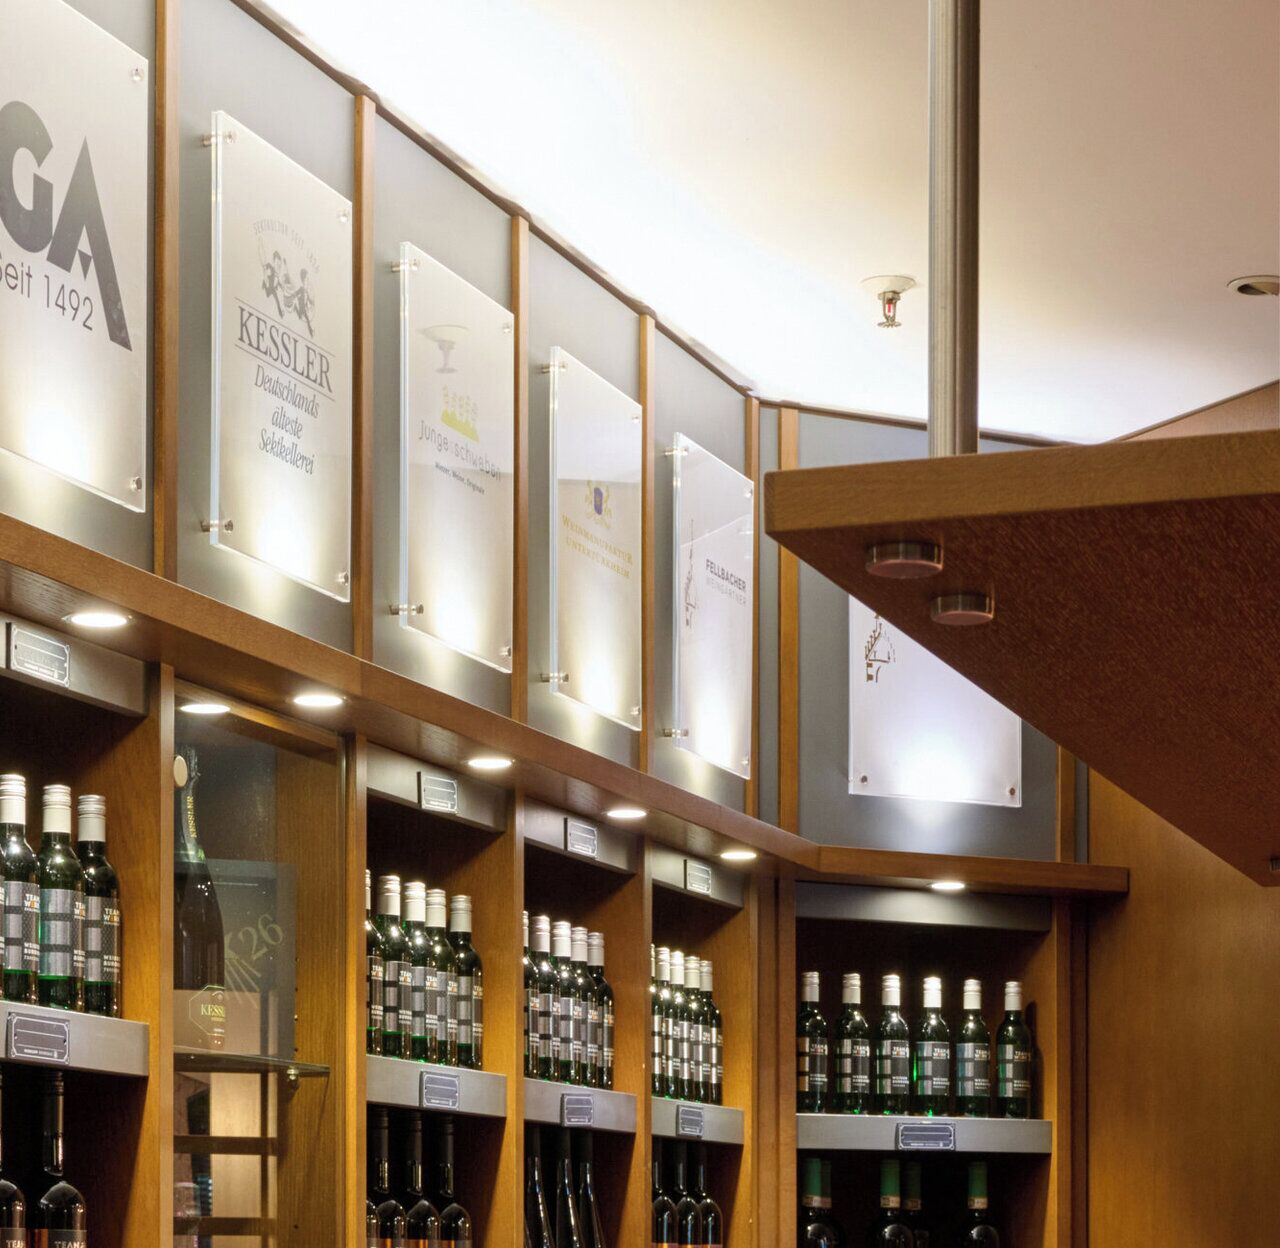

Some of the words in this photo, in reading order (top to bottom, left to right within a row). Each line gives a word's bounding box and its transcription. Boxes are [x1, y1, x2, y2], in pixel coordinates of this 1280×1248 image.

[43, 274, 94, 331] 1492
[238, 305, 333, 393] KESSLER
[254, 364, 320, 419] Deutschlands
[271, 406, 303, 440] älteste
[259, 428, 314, 475] Sektkellerei
[705, 558, 746, 592] FELLBACHER
